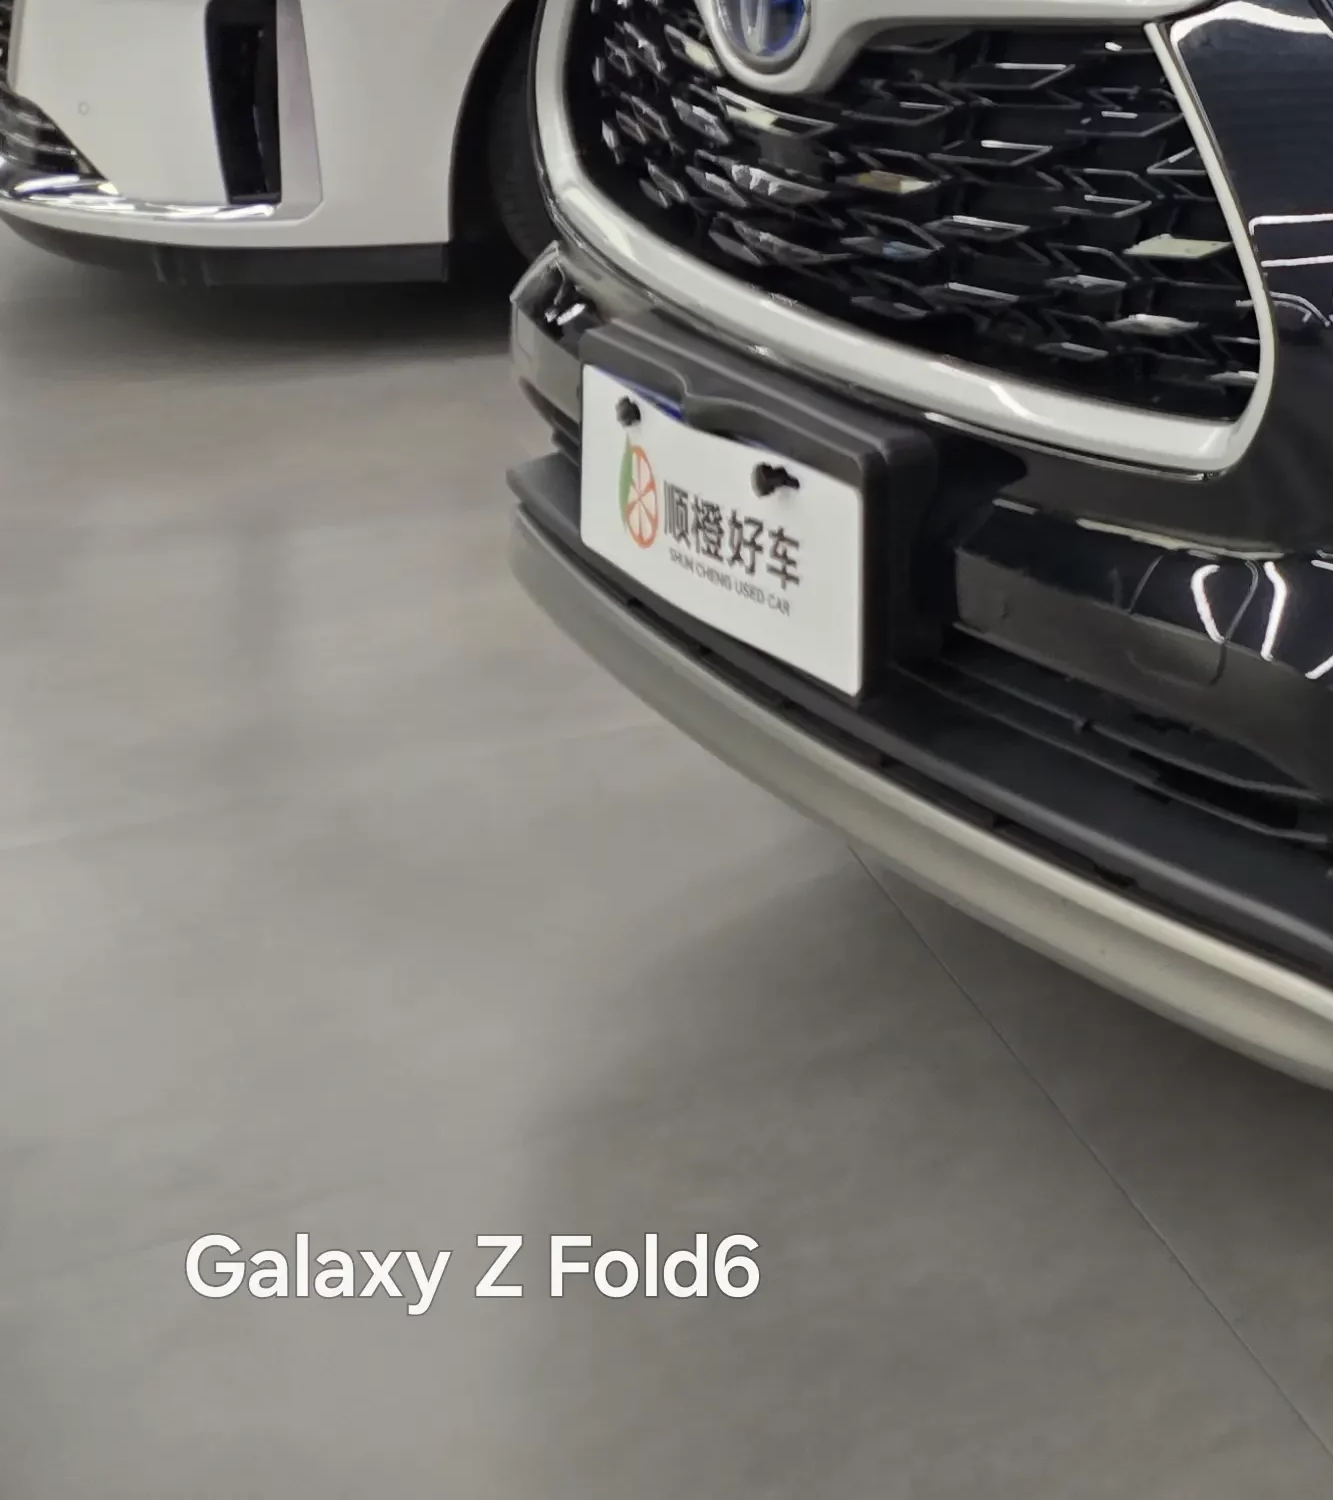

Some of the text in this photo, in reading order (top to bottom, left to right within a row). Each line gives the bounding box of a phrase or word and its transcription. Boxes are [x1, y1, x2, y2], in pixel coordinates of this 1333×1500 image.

[663, 479, 800, 591] 顺橙好车
[734, 579, 765, 605] USED
[767, 593, 790, 617] CAR
